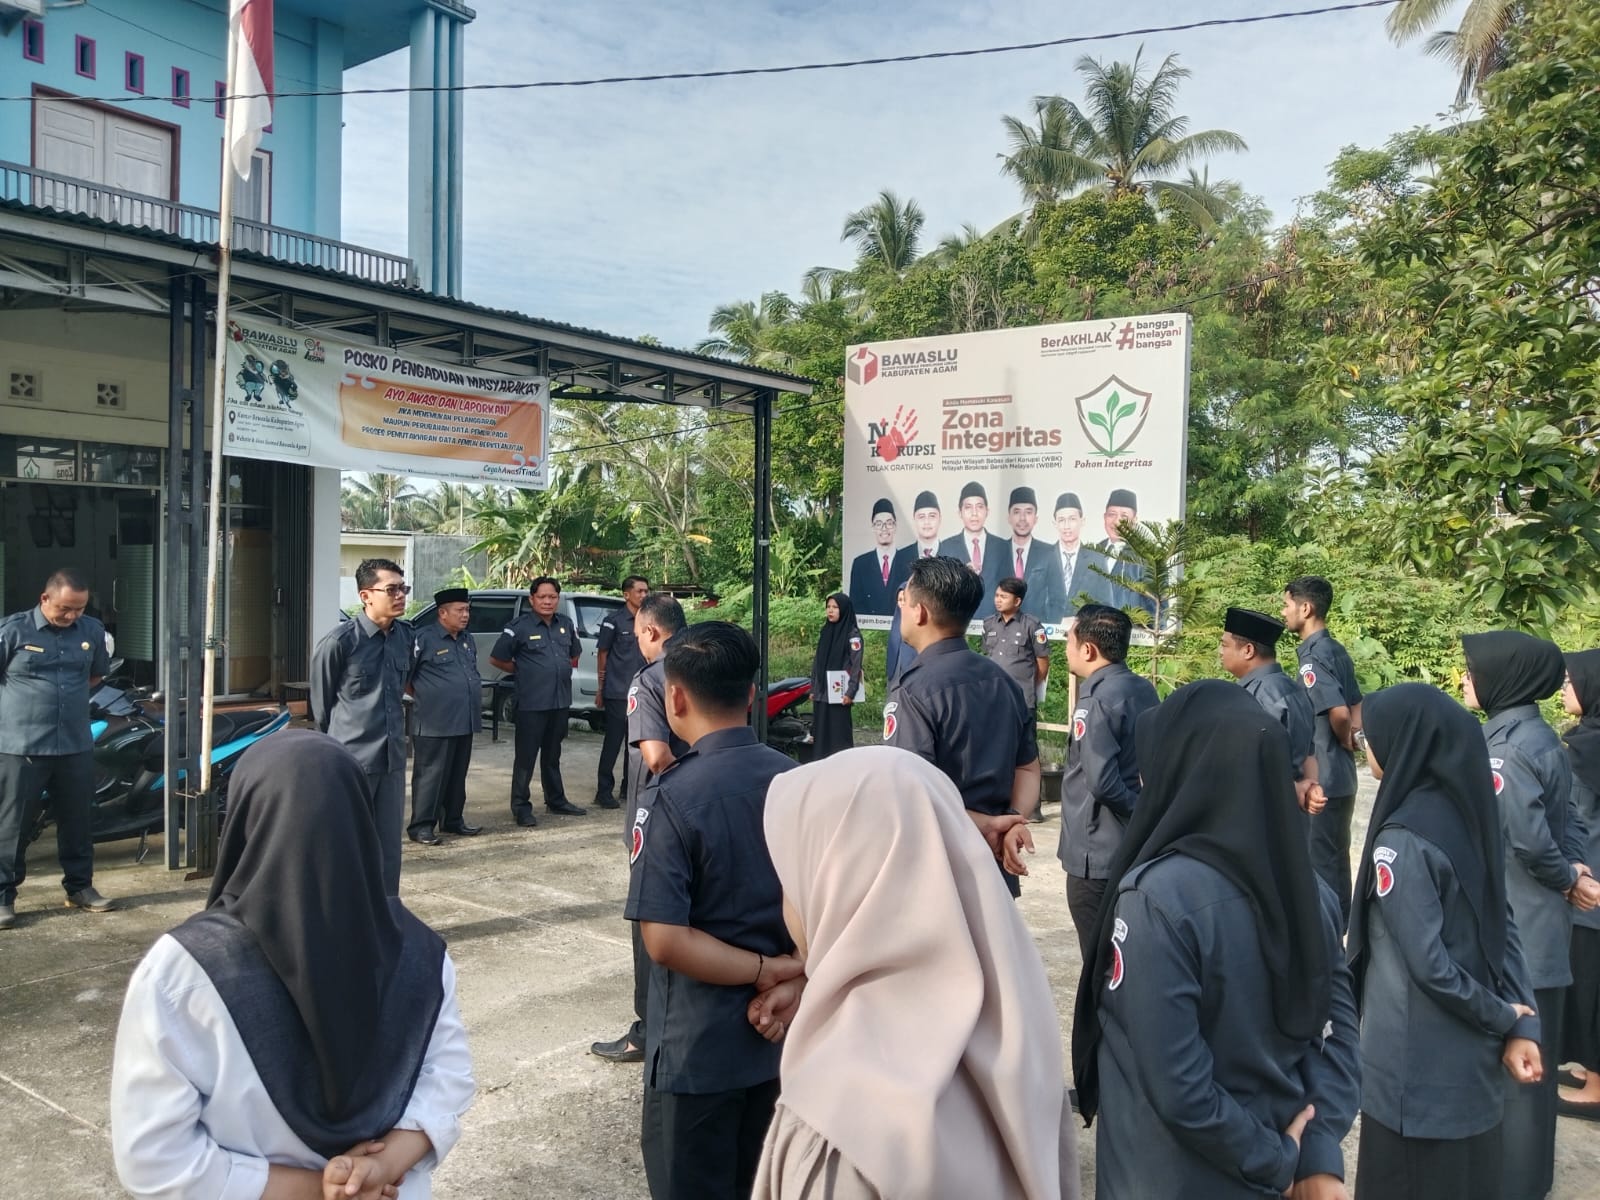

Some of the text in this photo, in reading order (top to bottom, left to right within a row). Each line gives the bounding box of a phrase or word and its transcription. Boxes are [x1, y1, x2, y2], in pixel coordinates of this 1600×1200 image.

[1136, 319, 1174, 330] bangga
[242, 328, 298, 347] BAWASLU
[1041, 331, 1112, 348] BerAKHLAK
[1136, 327, 1182, 339] melayani
[1136, 339, 1172, 349] bangsa
[881, 349, 958, 367] BAWASLU
[344, 349, 388, 371] POSKO
[392, 358, 465, 386] PENGADUAN
[466, 376, 541, 395] MASYARAKAT
[882, 367, 930, 378] KABUPATEN
[932, 365, 958, 374] AGAM
[384, 388, 511, 415] AYO AWASI DAN LAPORKAN!
[383, 417, 411, 427] MAUPUN
[942, 409, 1003, 429] Zona
[942, 426, 1062, 452] Integritas
[871, 444, 936, 457] KRUPSI
[1074, 459, 1152, 470] Pohon Integritas
